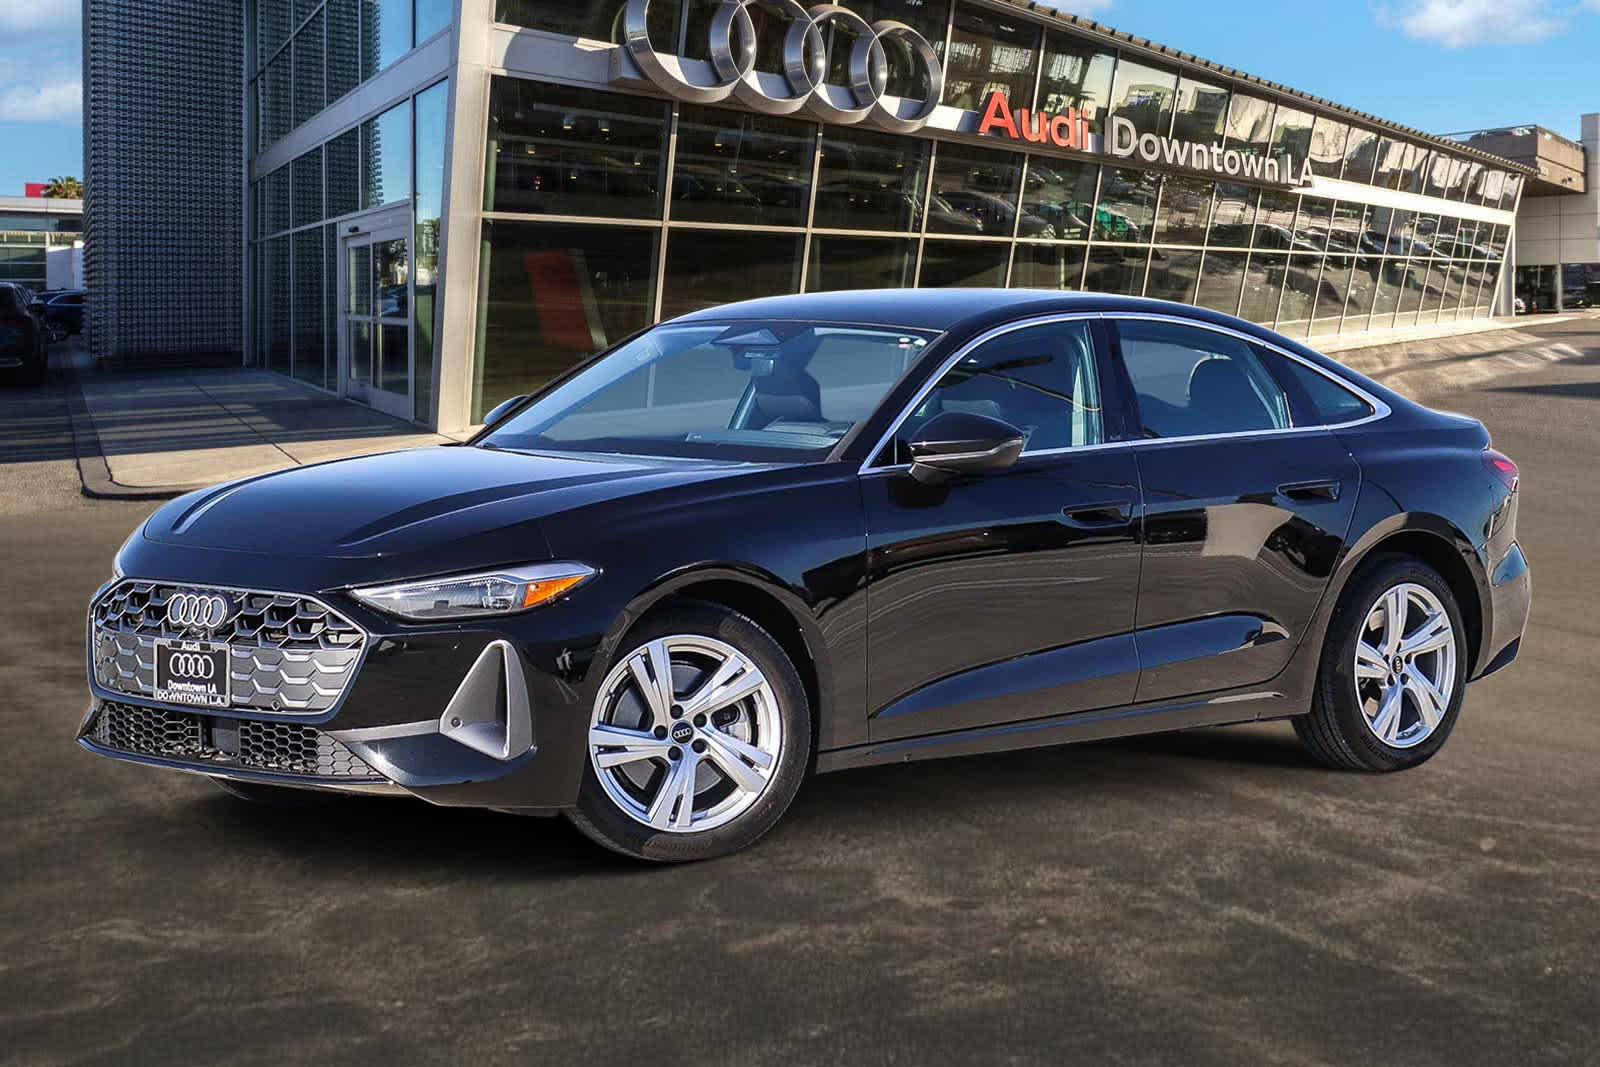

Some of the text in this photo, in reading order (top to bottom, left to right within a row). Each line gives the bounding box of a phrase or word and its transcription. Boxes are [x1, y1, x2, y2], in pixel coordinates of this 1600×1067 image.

[978, 91, 1315, 188] Audi Downtown LA
[181, 641, 200, 651] Audi
[168, 680, 217, 694] Downtown LA
[158, 691, 222, 705] DOWNTOWN LA
